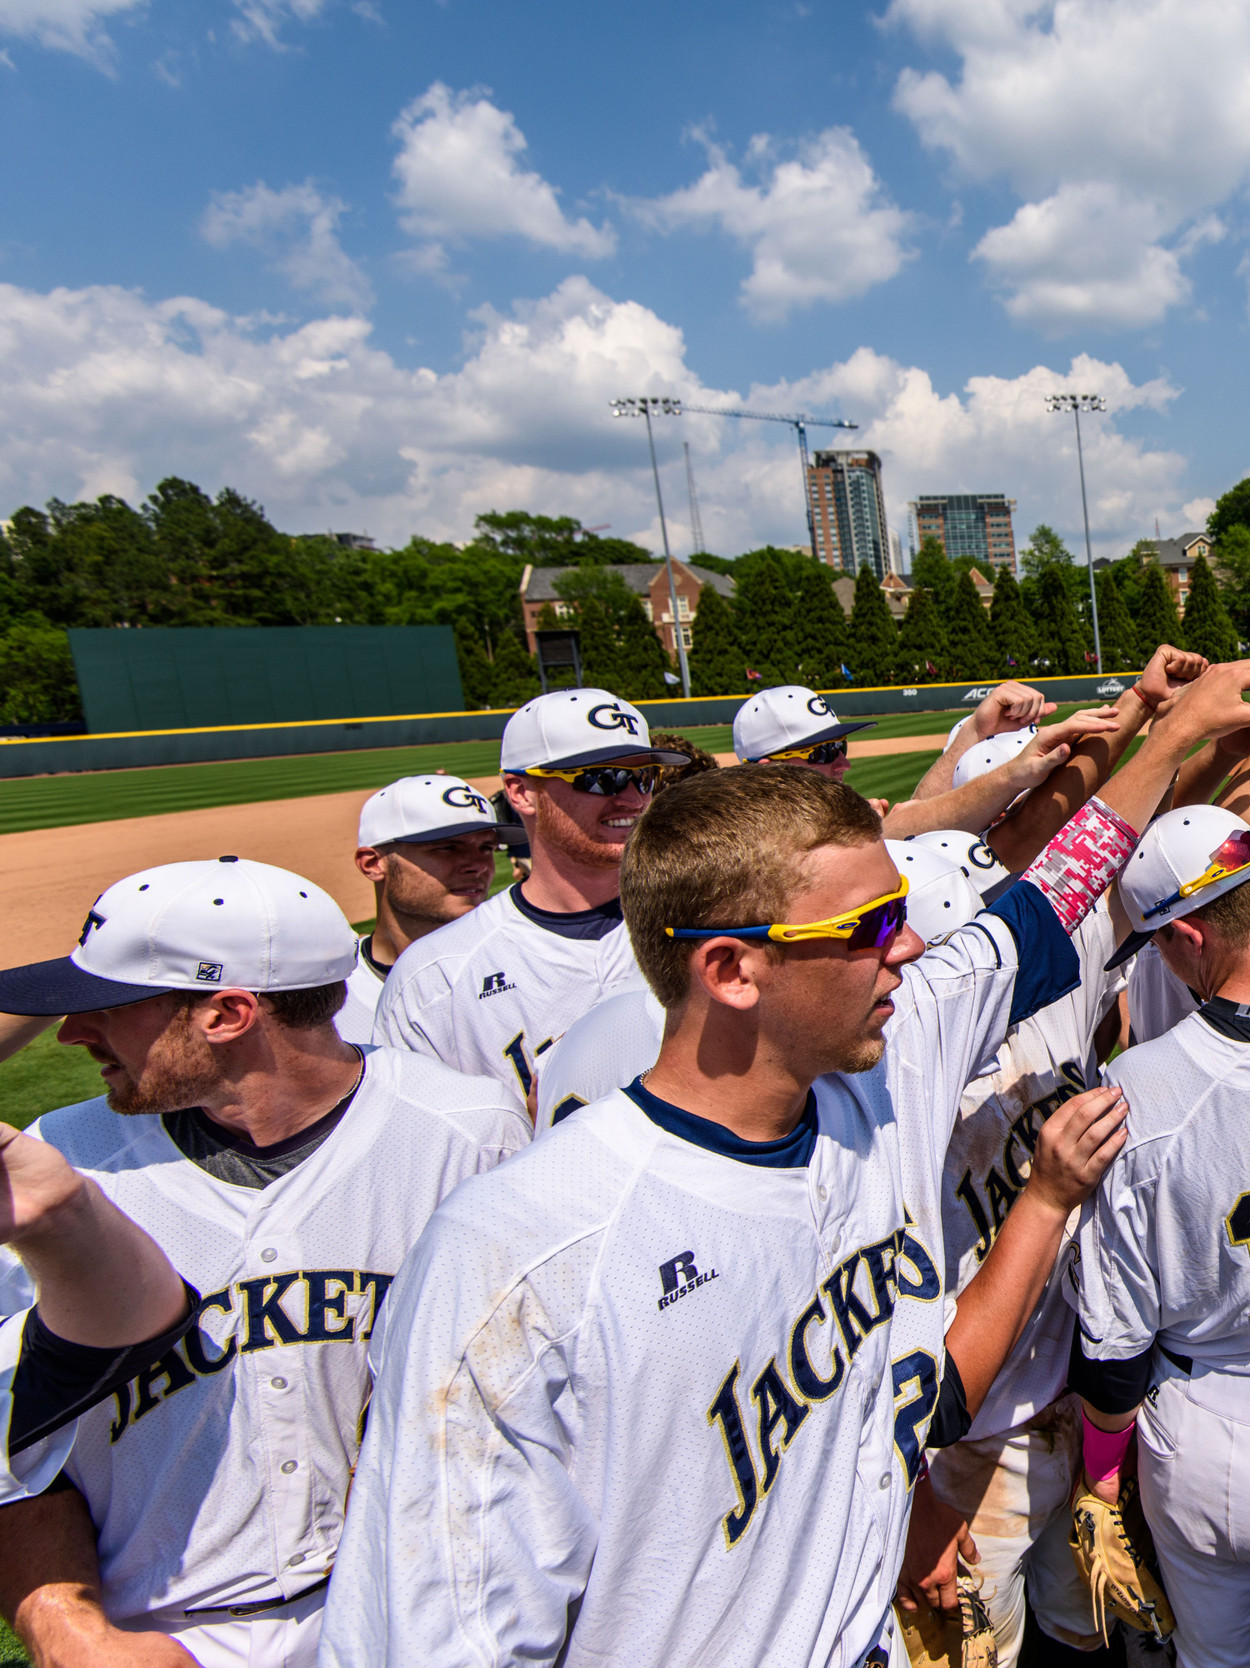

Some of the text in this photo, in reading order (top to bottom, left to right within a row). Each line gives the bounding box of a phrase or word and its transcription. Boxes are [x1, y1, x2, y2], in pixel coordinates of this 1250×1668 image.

[586, 703, 639, 736] GT
[441, 786, 488, 815] GT
[479, 983, 517, 999] RUSSELL
[657, 1268, 720, 1312] RUSSELL
